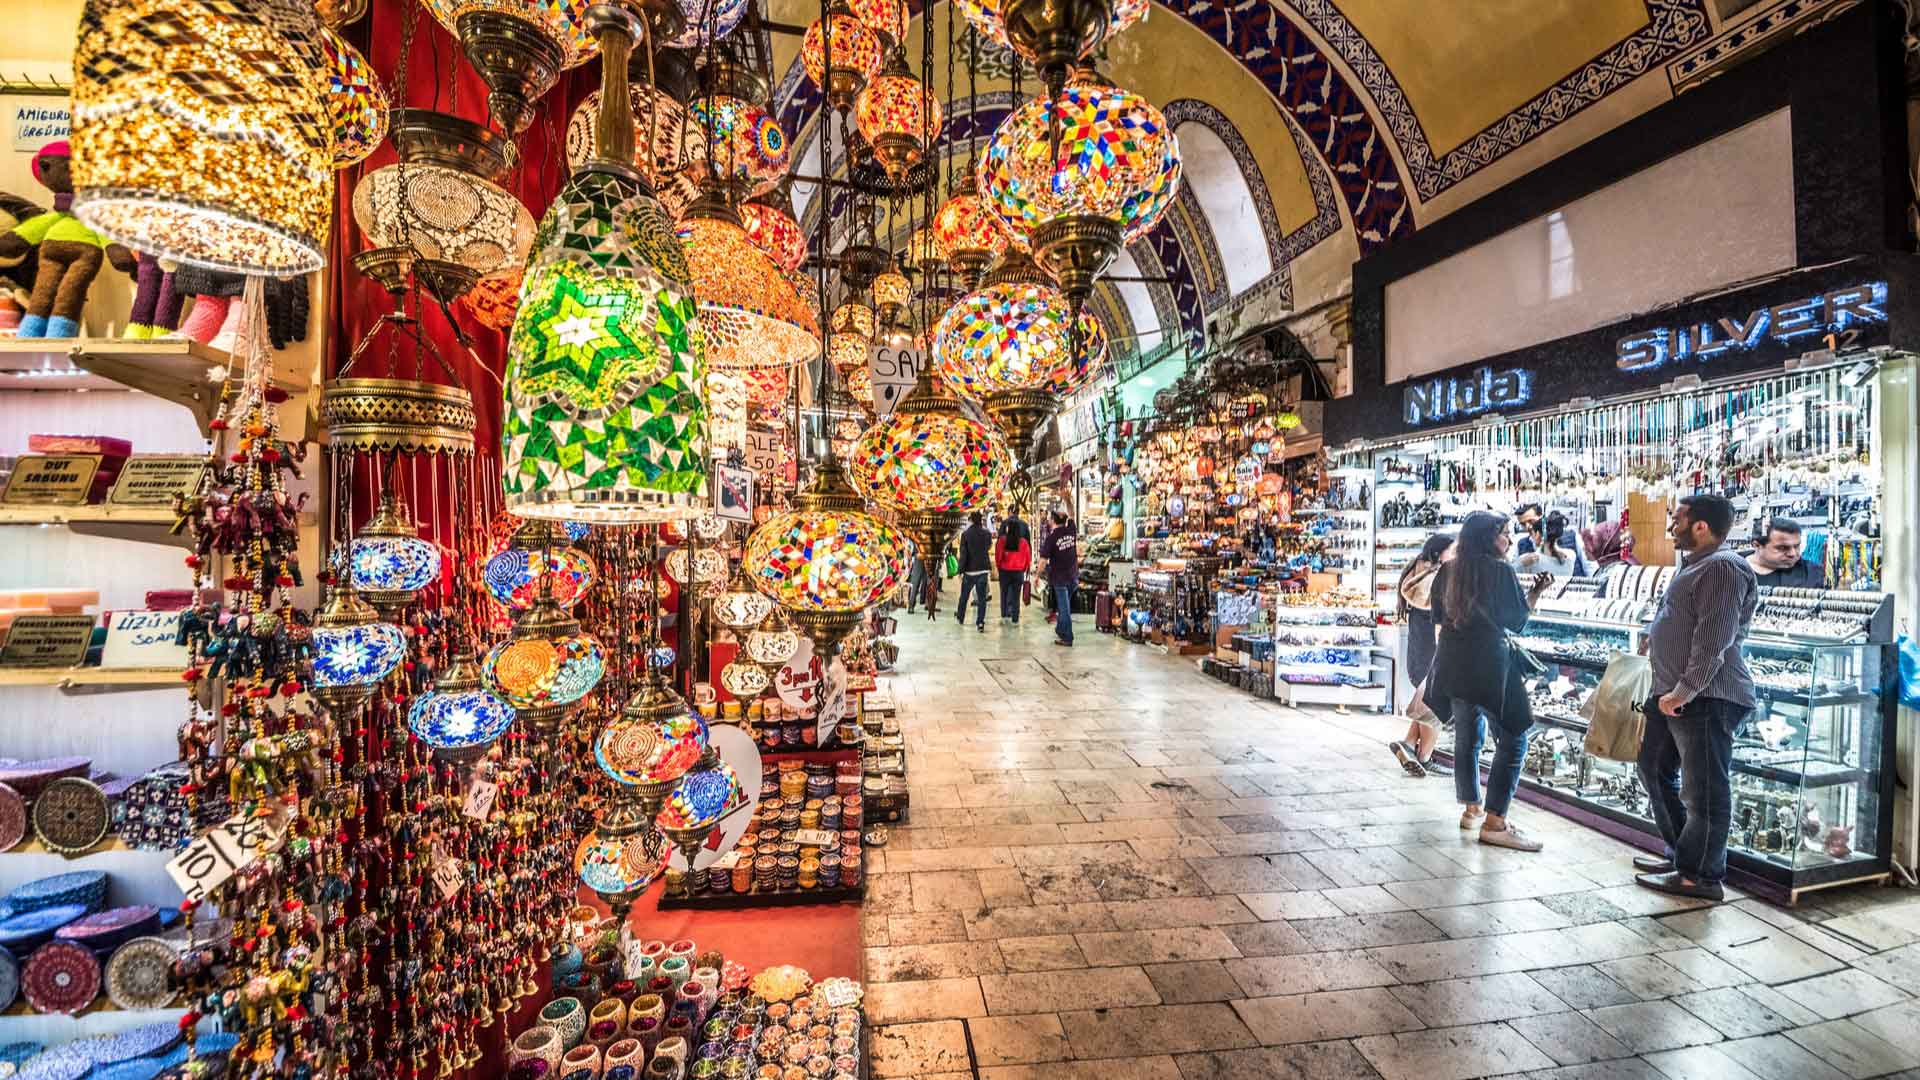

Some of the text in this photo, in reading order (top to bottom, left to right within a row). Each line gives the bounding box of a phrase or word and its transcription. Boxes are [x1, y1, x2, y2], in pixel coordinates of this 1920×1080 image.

[1823, 328, 1863, 352] 12
[1403, 282, 1889, 424] Nida SILVER
[44, 461, 72, 470] DUT
[781, 666, 792, 685] 3
[178, 843, 216, 879] 10
